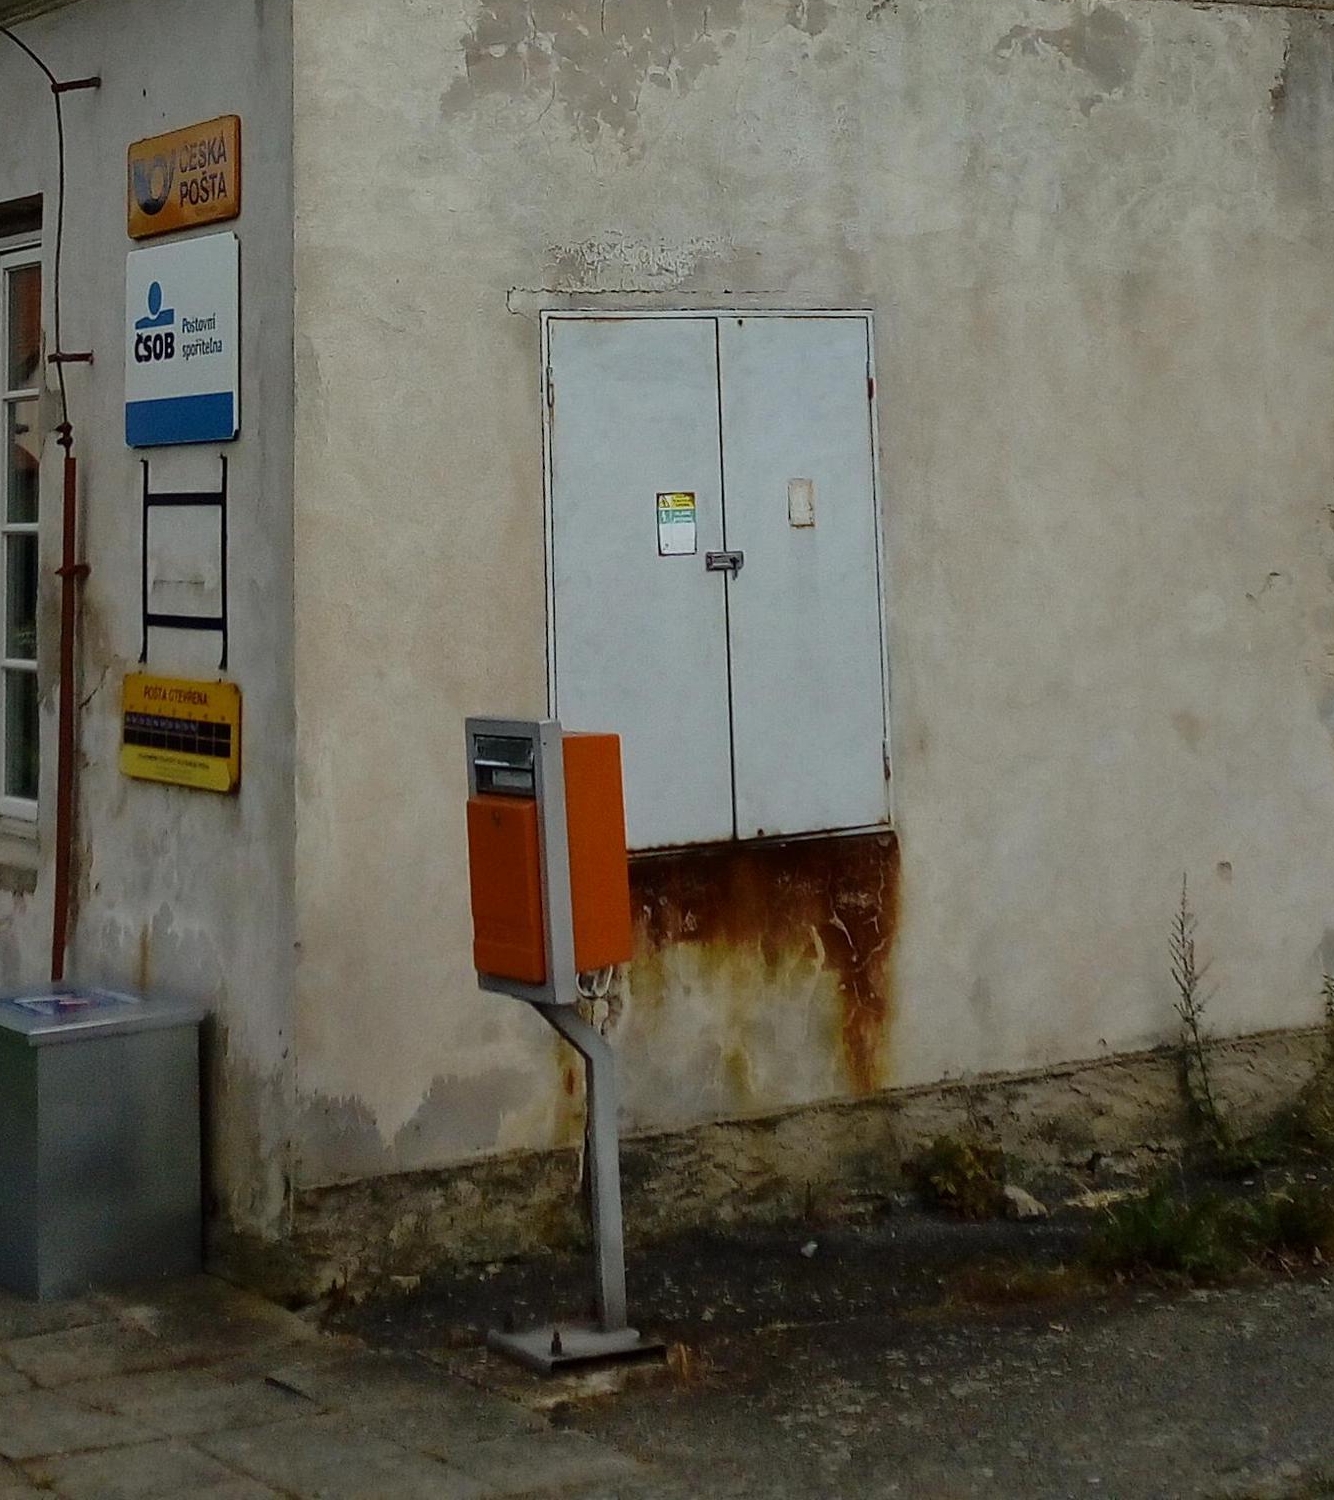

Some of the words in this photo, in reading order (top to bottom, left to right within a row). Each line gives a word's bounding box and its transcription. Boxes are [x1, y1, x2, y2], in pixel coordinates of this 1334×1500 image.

[178, 131, 227, 173] ČESKÁ
[179, 170, 227, 208] POŠTA
[134, 332, 175, 363] ČSOB
[182, 337, 223, 360] spořitelna
